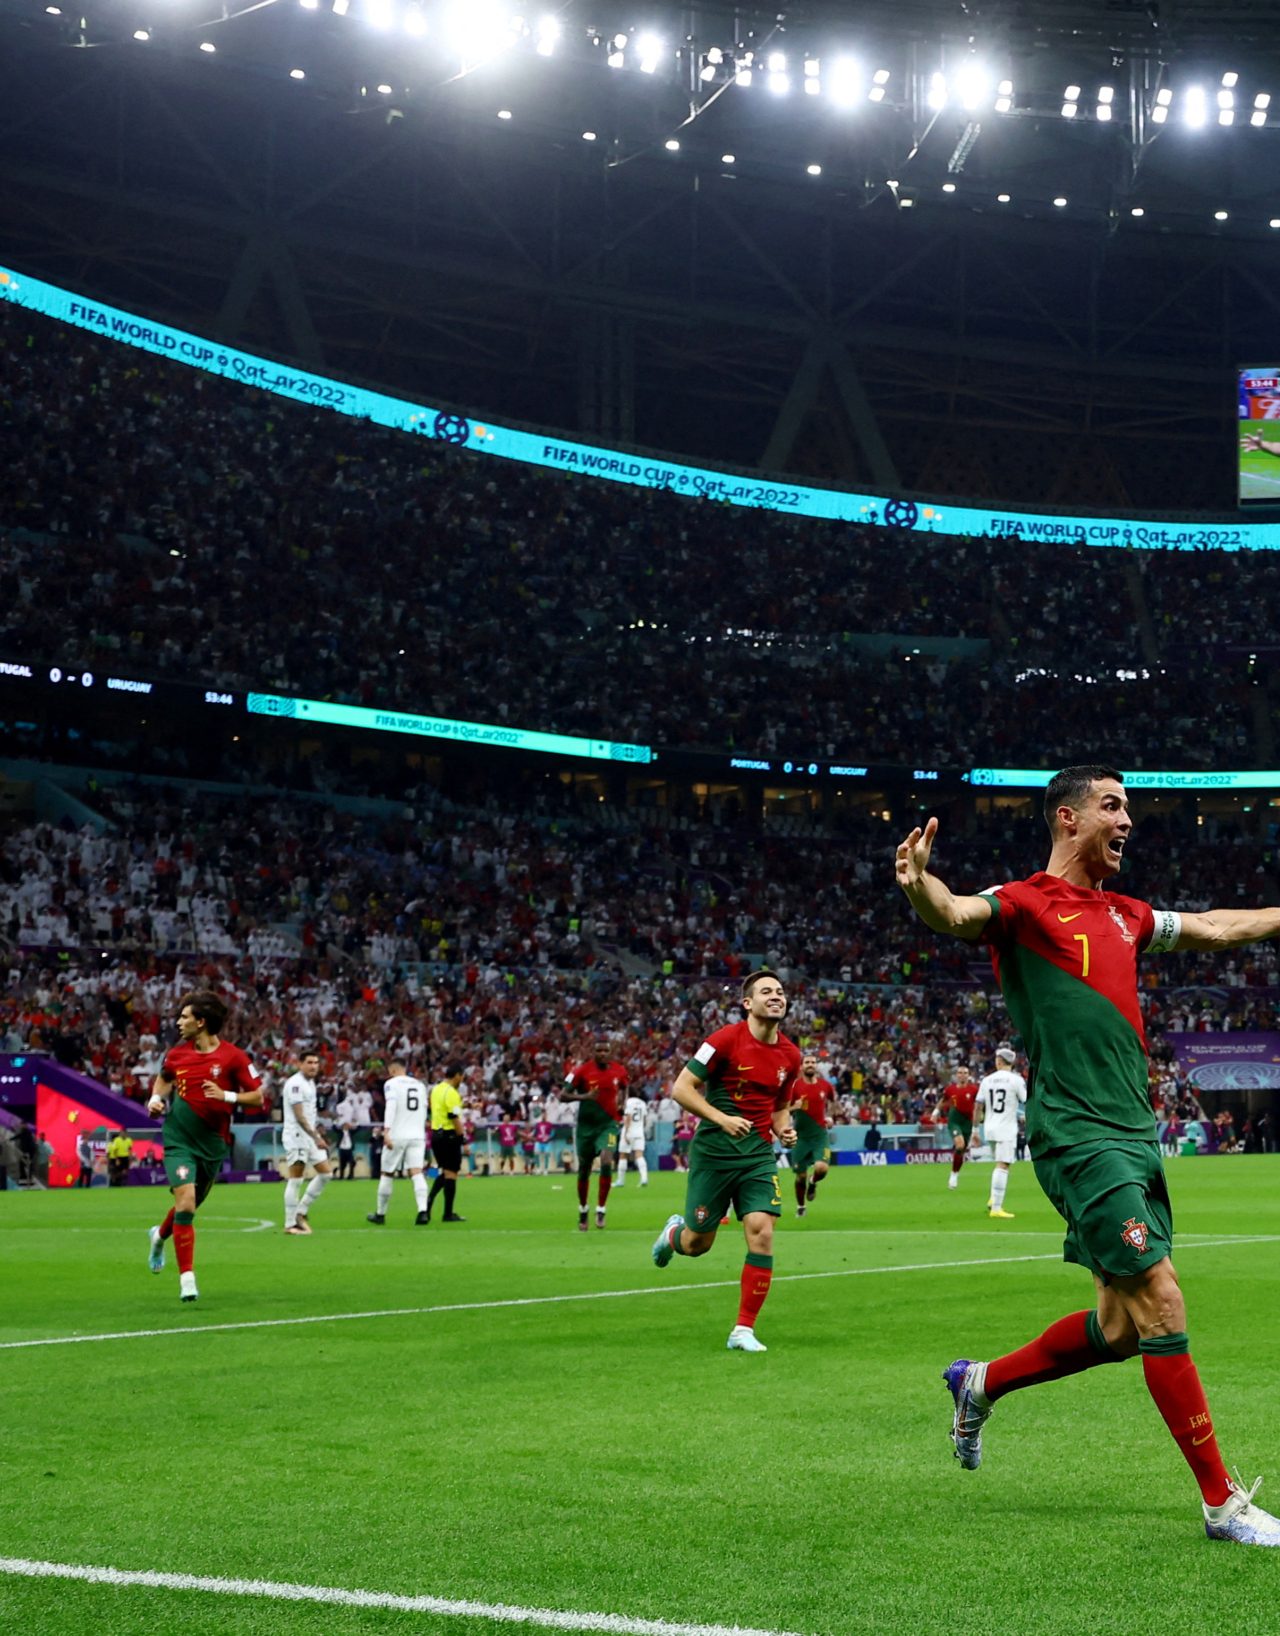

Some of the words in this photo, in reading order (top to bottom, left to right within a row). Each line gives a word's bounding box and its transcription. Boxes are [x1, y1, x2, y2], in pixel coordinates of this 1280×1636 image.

[70, 302, 108, 328] FIFA
[111, 317, 177, 350] WORLD
[180, 341, 214, 362] CUP
[543, 445, 579, 465] FIFA
[581, 453, 642, 477] WORLD
[644, 467, 676, 485] CUP
[990, 519, 1026, 535] FIFA
[1027, 521, 1087, 538] WORLD
[1088, 526, 1120, 539] CUP
[50, 668, 61, 683] 0
[82, 672, 93, 687] 0
[107, 677, 152, 693] URUGUAY
[375, 715, 397, 727] FIFA
[399, 718, 432, 731] WORLD
[433, 723, 451, 734] CUP
[731, 758, 770, 770] PORTUGAL
[783, 761, 793, 773] 0
[808, 763, 818, 775] 0
[829, 766, 868, 776] URUGUAY
[1136, 776, 1156, 785] CUP
[1073, 933, 1091, 977] 7
[407, 1087, 419, 1111] 6
[989, 1088, 1006, 1114] 13
[858, 1152, 888, 1166] VISA
[906, 1153, 935, 1165] QATAR
